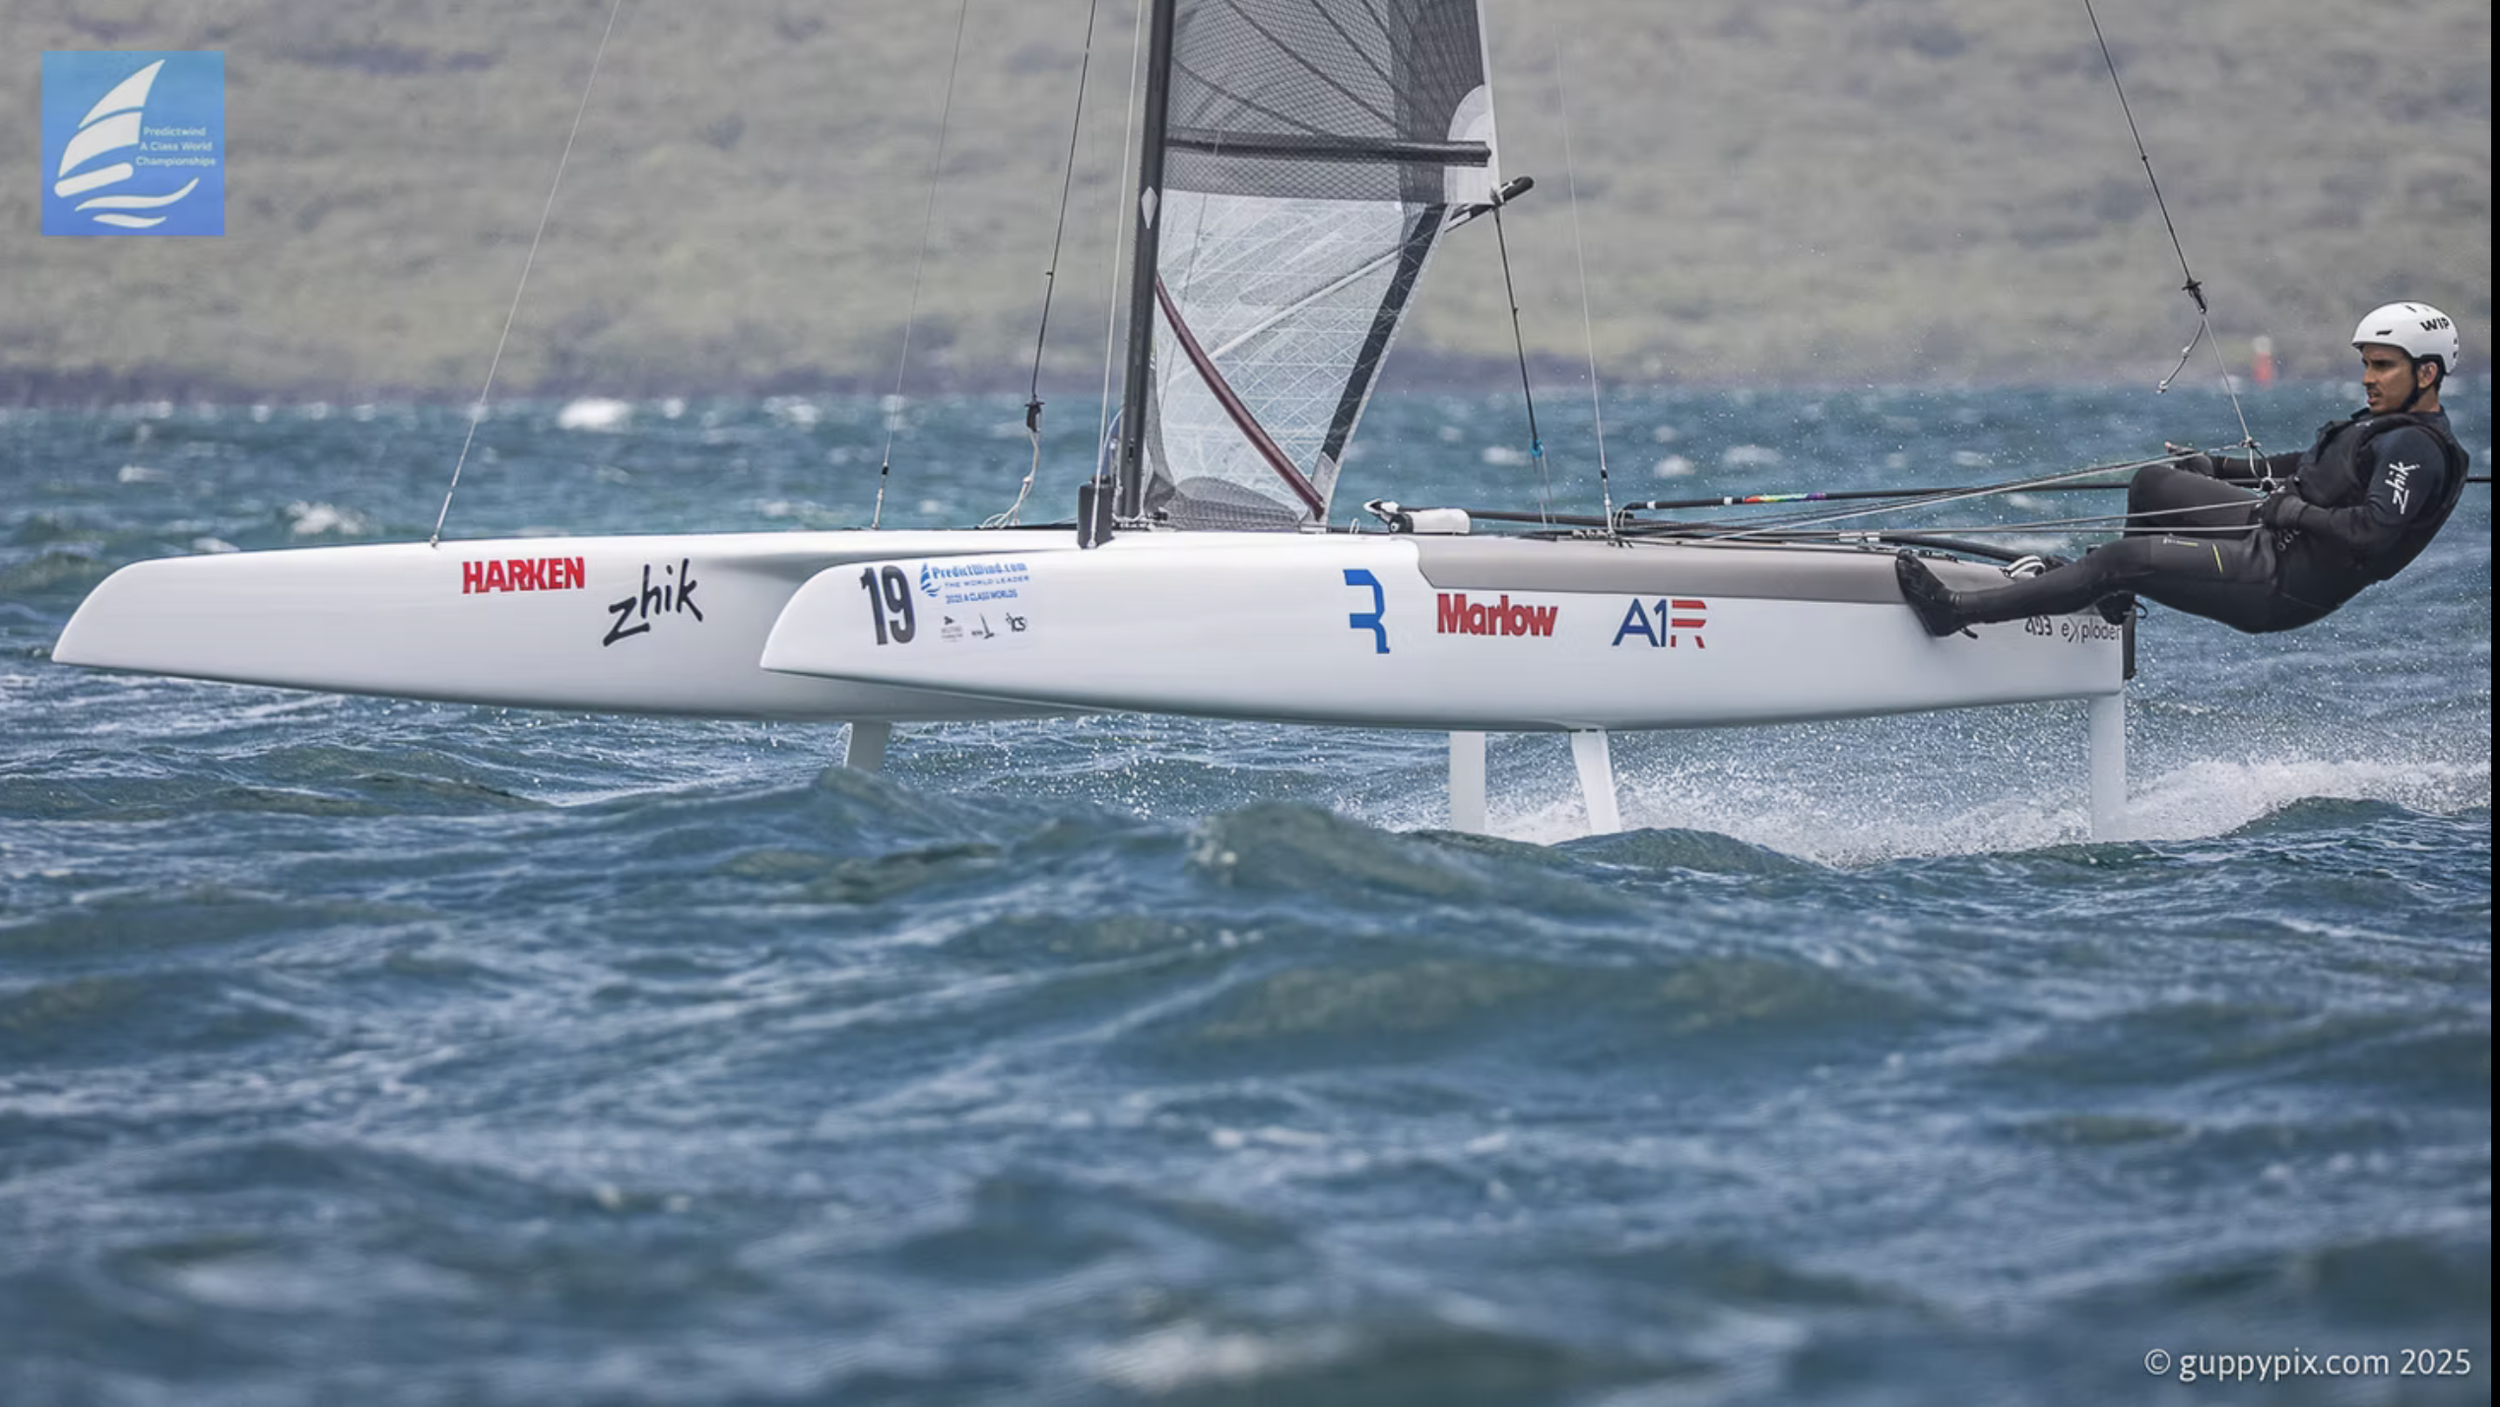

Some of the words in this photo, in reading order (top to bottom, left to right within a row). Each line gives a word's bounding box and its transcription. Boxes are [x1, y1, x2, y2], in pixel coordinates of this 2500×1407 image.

[2419, 317, 2450, 331] WIP
[462, 556, 585, 594] HARKEN
[963, 577, 994, 586] WORLD
[995, 574, 1030, 584] LEADER
[859, 564, 916, 645] 19
[1437, 593, 1558, 636] Marlow
